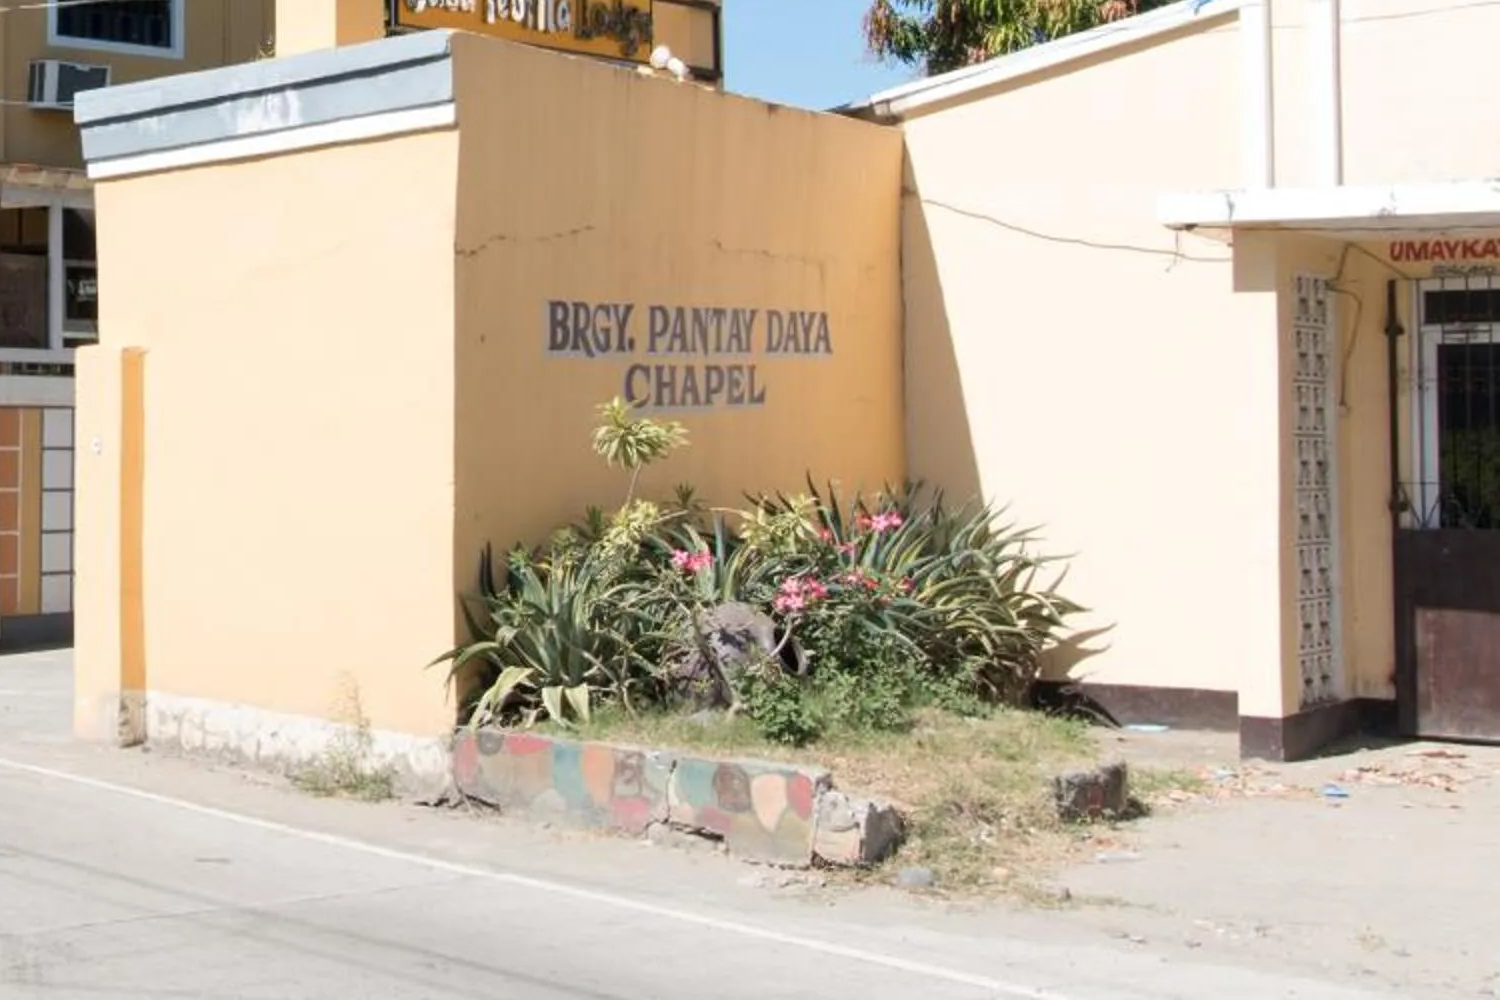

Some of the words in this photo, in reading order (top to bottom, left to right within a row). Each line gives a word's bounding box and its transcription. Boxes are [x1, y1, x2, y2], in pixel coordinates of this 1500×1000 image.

[1390, 239, 1500, 261] UMAYKA
[548, 300, 635, 357] BRGY.
[646, 304, 758, 355] PANTAY
[765, 309, 833, 354] DAYA
[624, 362, 767, 408] CHAPEL
